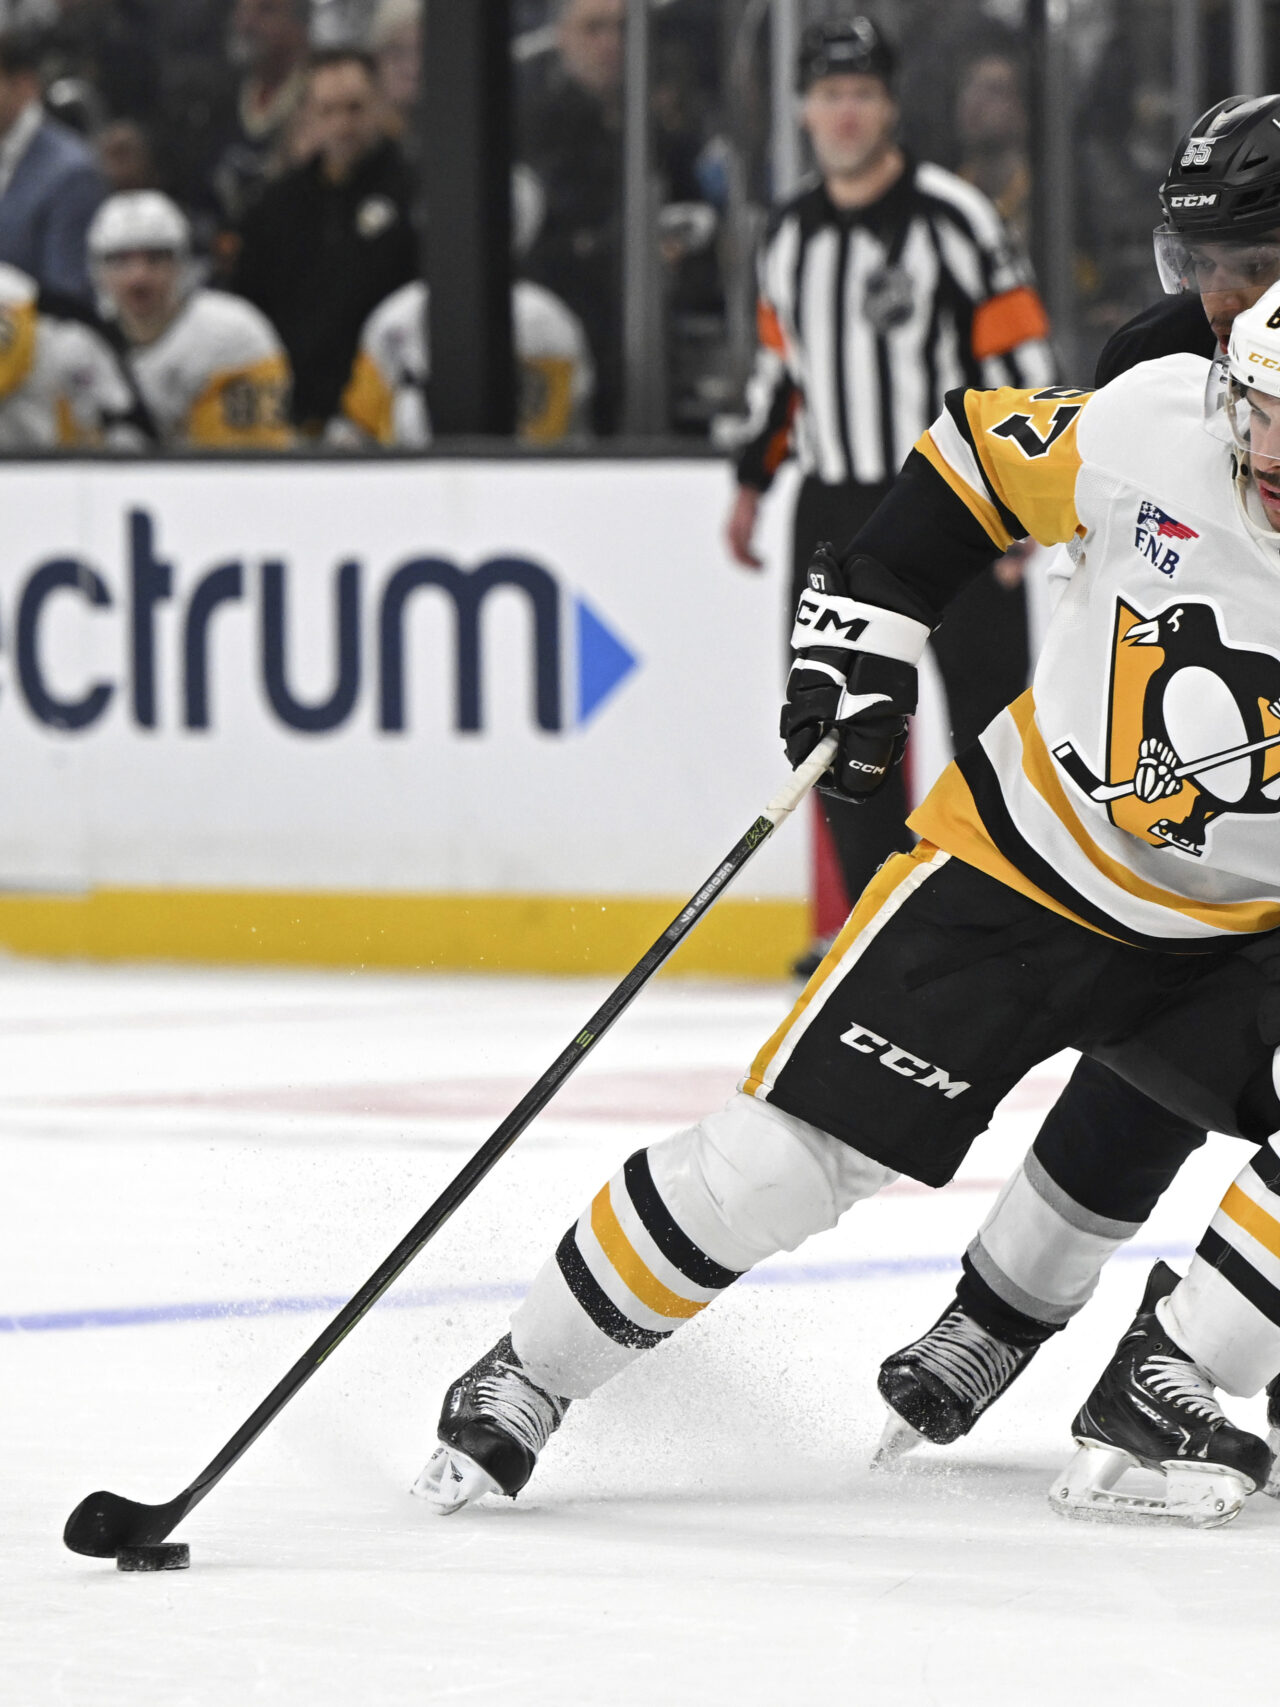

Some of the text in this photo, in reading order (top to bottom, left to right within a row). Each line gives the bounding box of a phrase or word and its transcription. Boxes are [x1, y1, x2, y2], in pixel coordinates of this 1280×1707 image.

[1180, 137, 1216, 166] 55
[1170, 193, 1217, 208] CCM
[1134, 527, 1180, 579] F.N.B.
[809, 573, 826, 591] 87
[0, 504, 562, 734] ctrum
[848, 759, 888, 775] CCM
[694, 862, 733, 907] CROSBY
[839, 1021, 972, 1100] CCM
